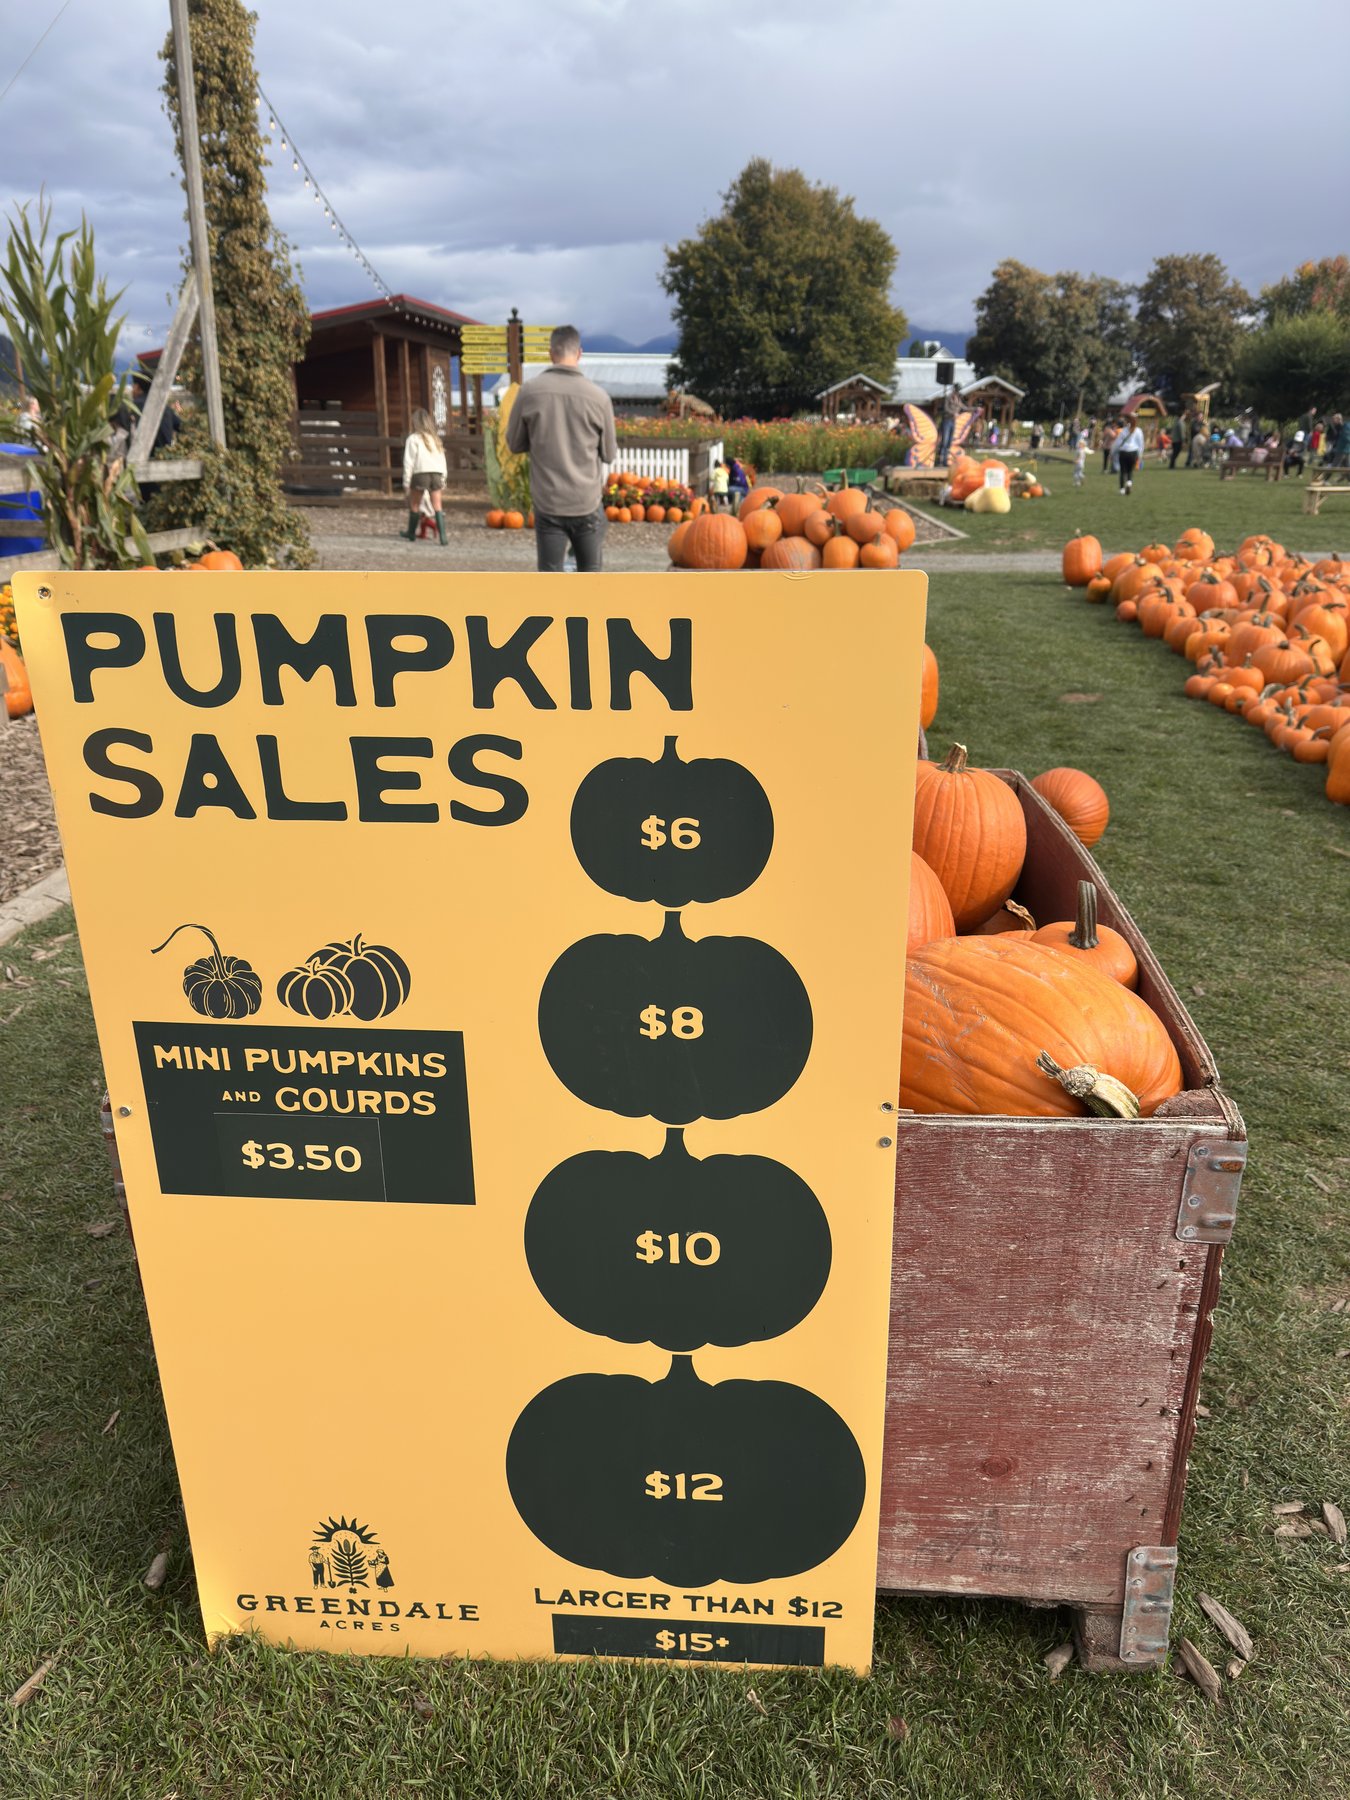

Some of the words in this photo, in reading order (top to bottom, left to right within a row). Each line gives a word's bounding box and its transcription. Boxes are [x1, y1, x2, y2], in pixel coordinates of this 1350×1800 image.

[61, 612, 693, 711] PUMPKIN
[83, 728, 529, 826] SALES
[641, 815, 701, 850] $6
[640, 1005, 703, 1039] $8
[154, 1045, 230, 1070] MINI
[245, 1049, 446, 1077] PUMPKINS
[223, 1091, 260, 1102] AND
[276, 1087, 436, 1115] GOURDS
[242, 1140, 361, 1172] $3.50
[636, 1231, 720, 1265] $10
[646, 1471, 723, 1501] $12
[237, 1594, 479, 1621] GREENDALE
[535, 1588, 670, 1610] LARGER
[683, 1595, 773, 1615] THAN
[789, 1596, 842, 1618] $12
[320, 1621, 399, 1631] ACRES
[656, 1630, 729, 1651] $15+
